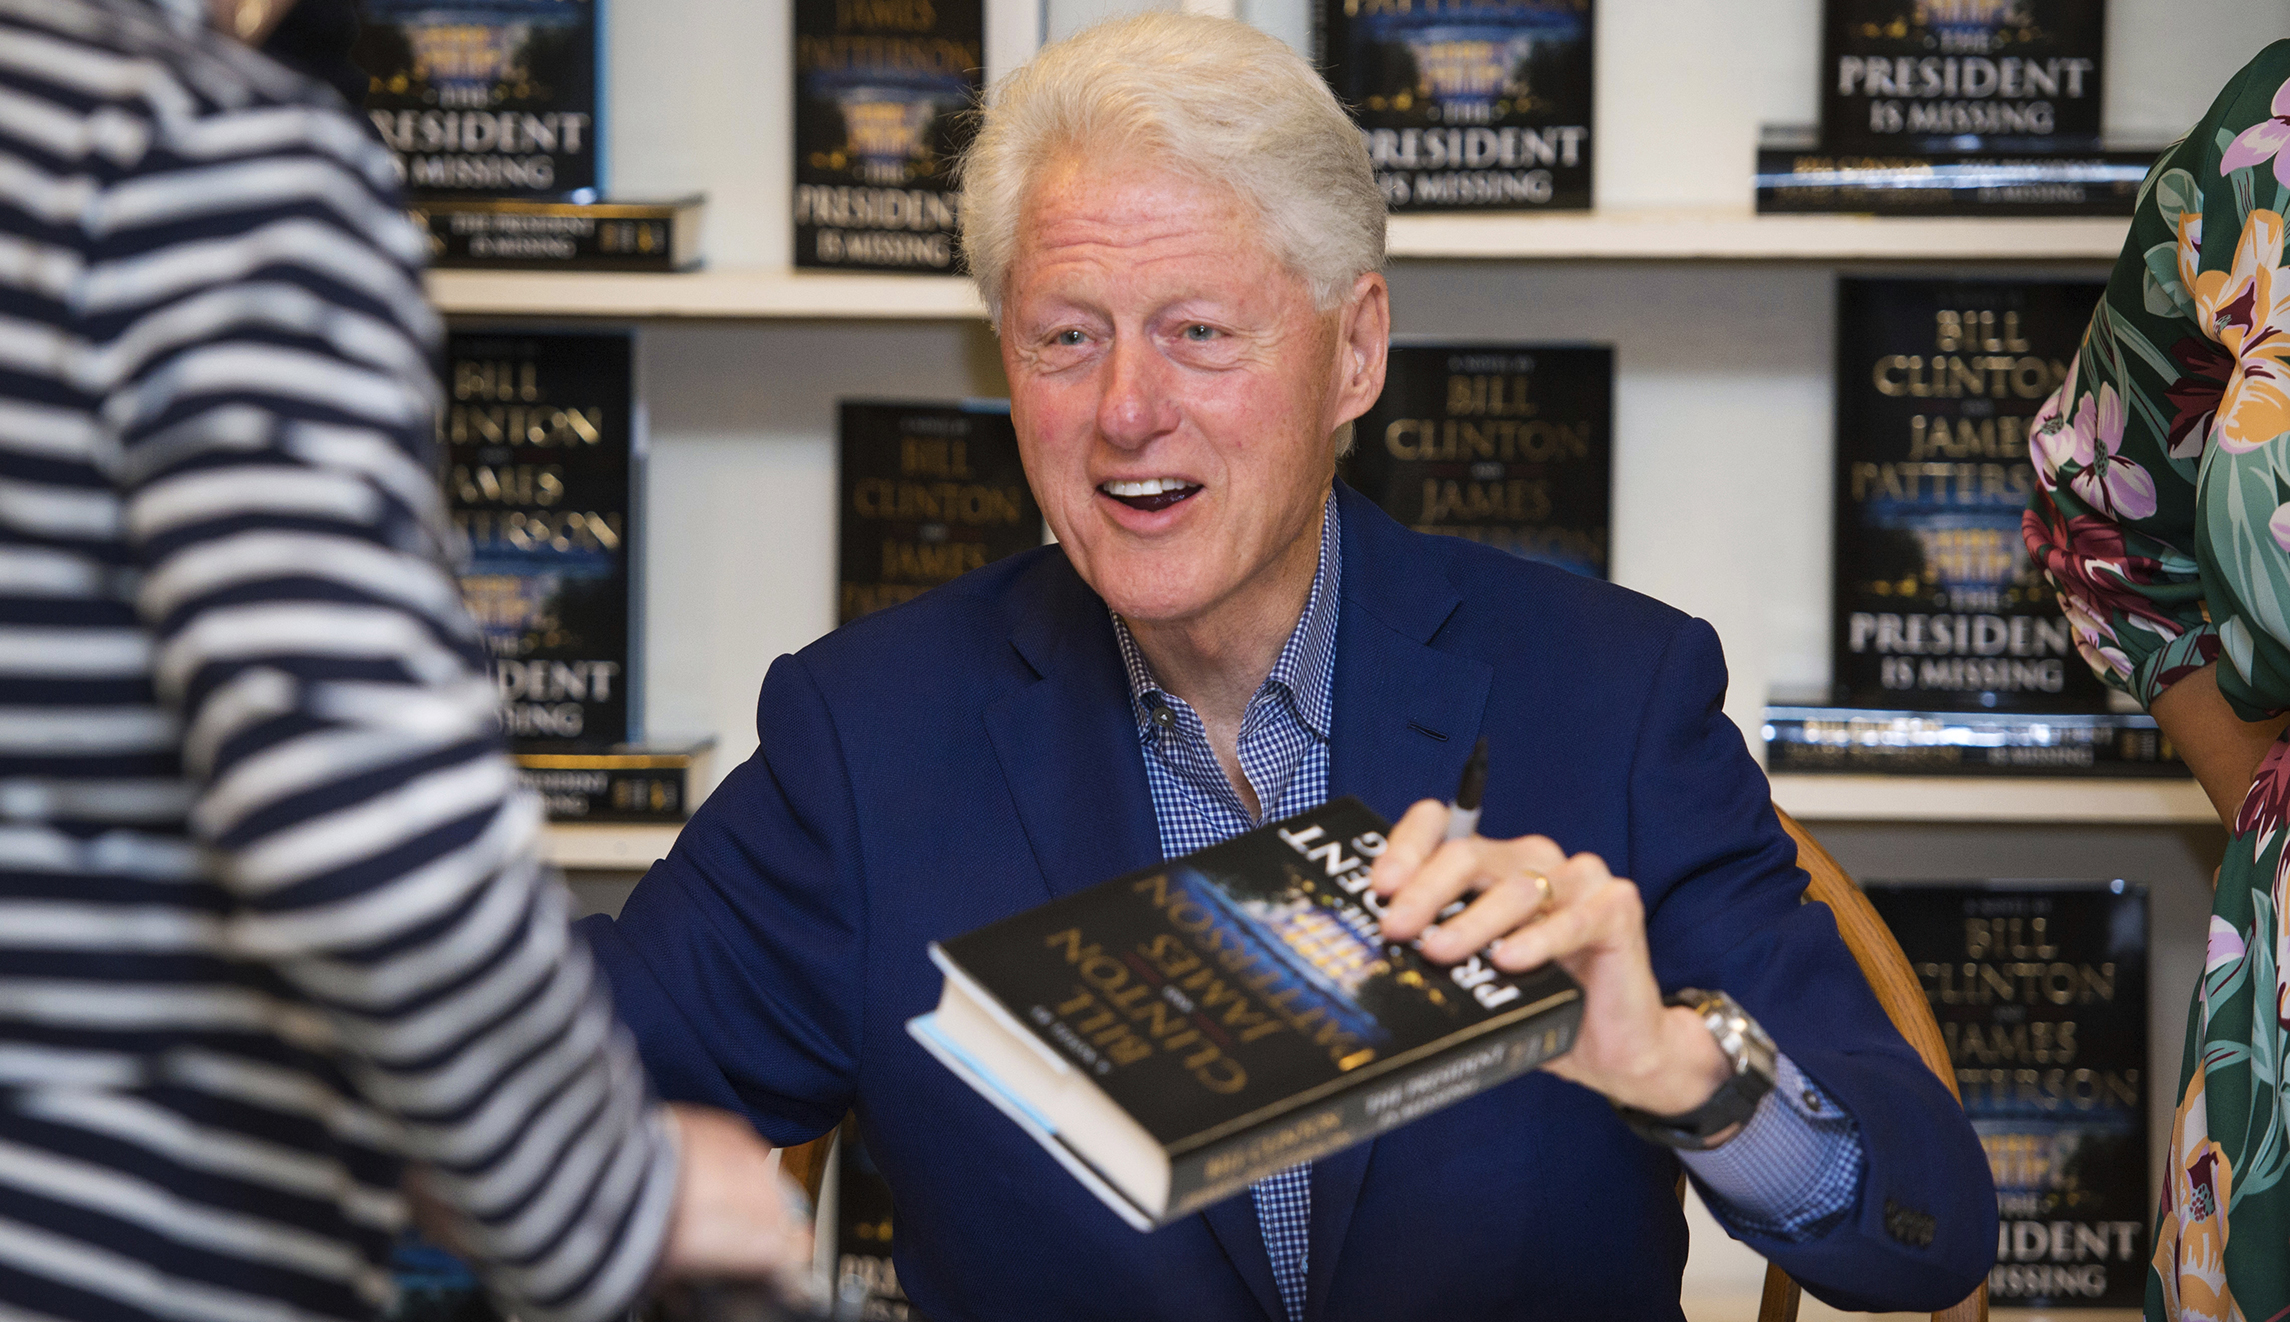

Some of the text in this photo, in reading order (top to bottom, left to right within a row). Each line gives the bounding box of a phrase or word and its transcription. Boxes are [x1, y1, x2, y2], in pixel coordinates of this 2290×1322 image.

[1838, 55, 2093, 99] PRESIDENT
[1870, 100, 2056, 135] IS MISSING
[1413, 168, 1553, 205] MISSING
[1936, 309, 2030, 353] BILL
[1446, 374, 1538, 417] BILL
[1385, 417, 1590, 463] CLINTON
[453, 463, 564, 506] AMES
[1420, 476, 1550, 525] JAMES
[1849, 611, 2072, 656] PRESIDEN
[1918, 656, 2065, 693] MISSING
[1965, 917, 2058, 961] BILL
[1132, 872, 1377, 1073] PATTERSON
[1137, 933, 1286, 1043] JAMES
[1046, 927, 1248, 1095] CLINTON
